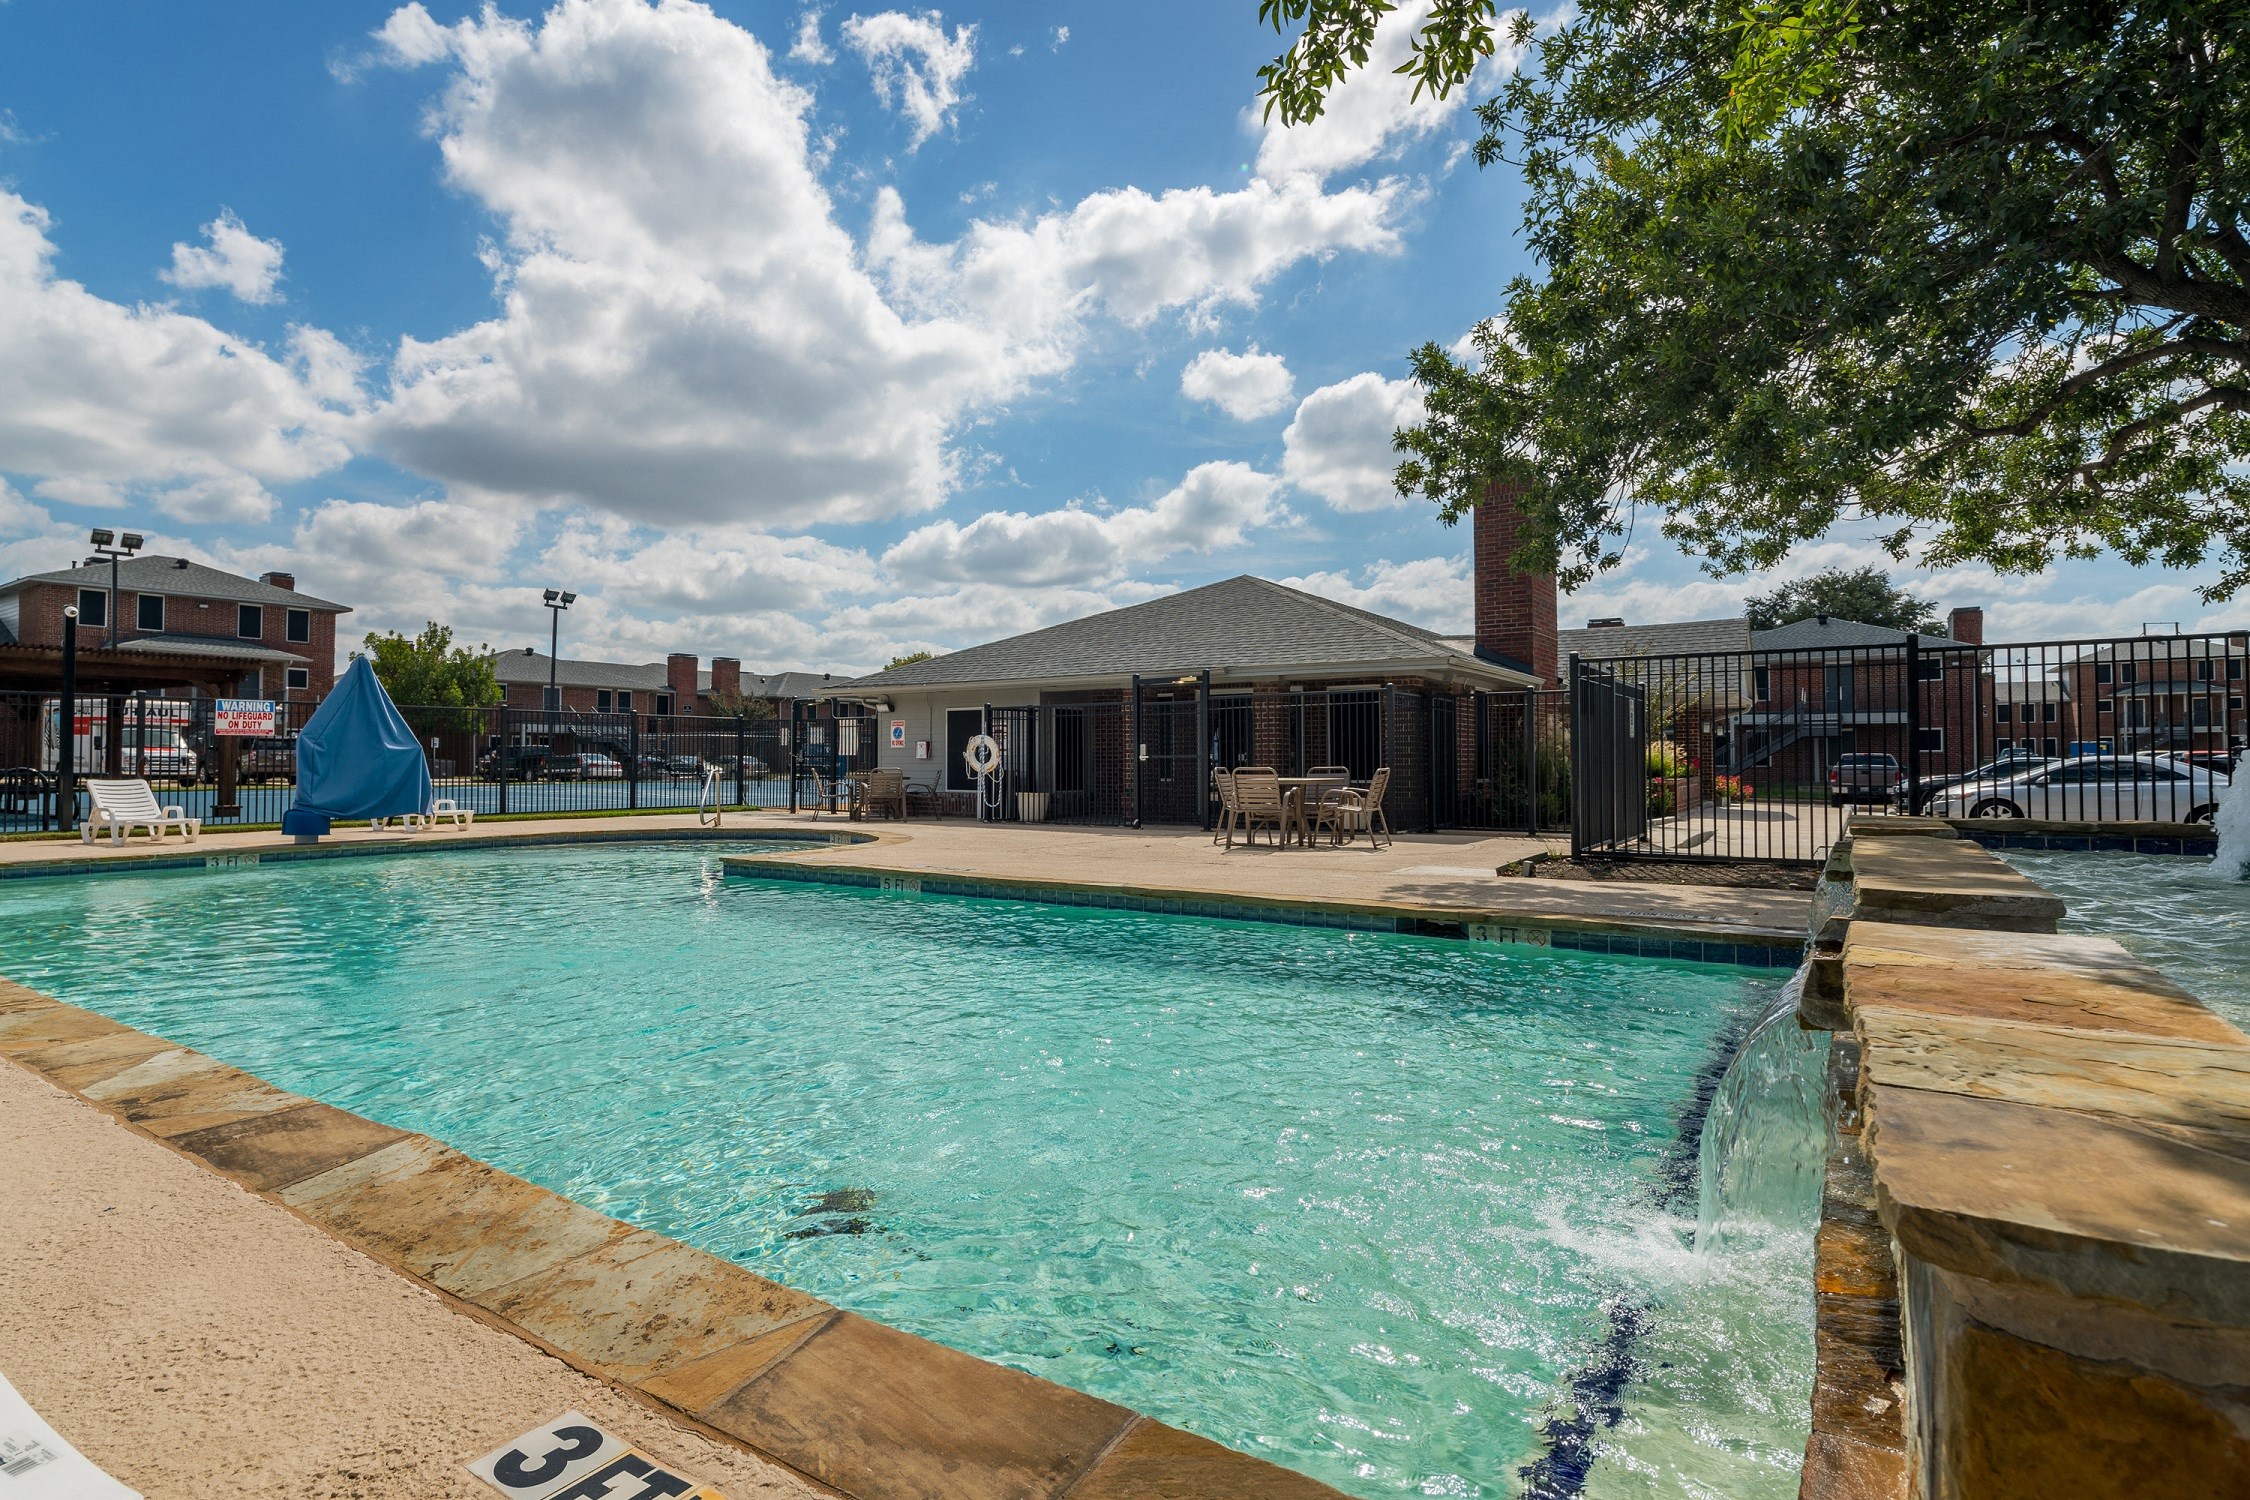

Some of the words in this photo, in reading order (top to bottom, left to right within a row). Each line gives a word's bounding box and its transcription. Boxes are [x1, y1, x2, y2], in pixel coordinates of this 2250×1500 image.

[222, 701, 270, 711] WARNING
[217, 712, 229, 720] NO
[232, 712, 273, 721] LIFEGUARD
[228, 721, 239, 729] ON
[242, 721, 263, 729] DUTY
[211, 857, 220, 867] 3
[227, 856, 239, 866] FT
[883, 878, 891, 890] 5
[895, 879, 905, 891] FT
[1476, 926, 1488, 941] 3
[1500, 927, 1519, 944] FT
[493, 1426, 604, 1488] 3
